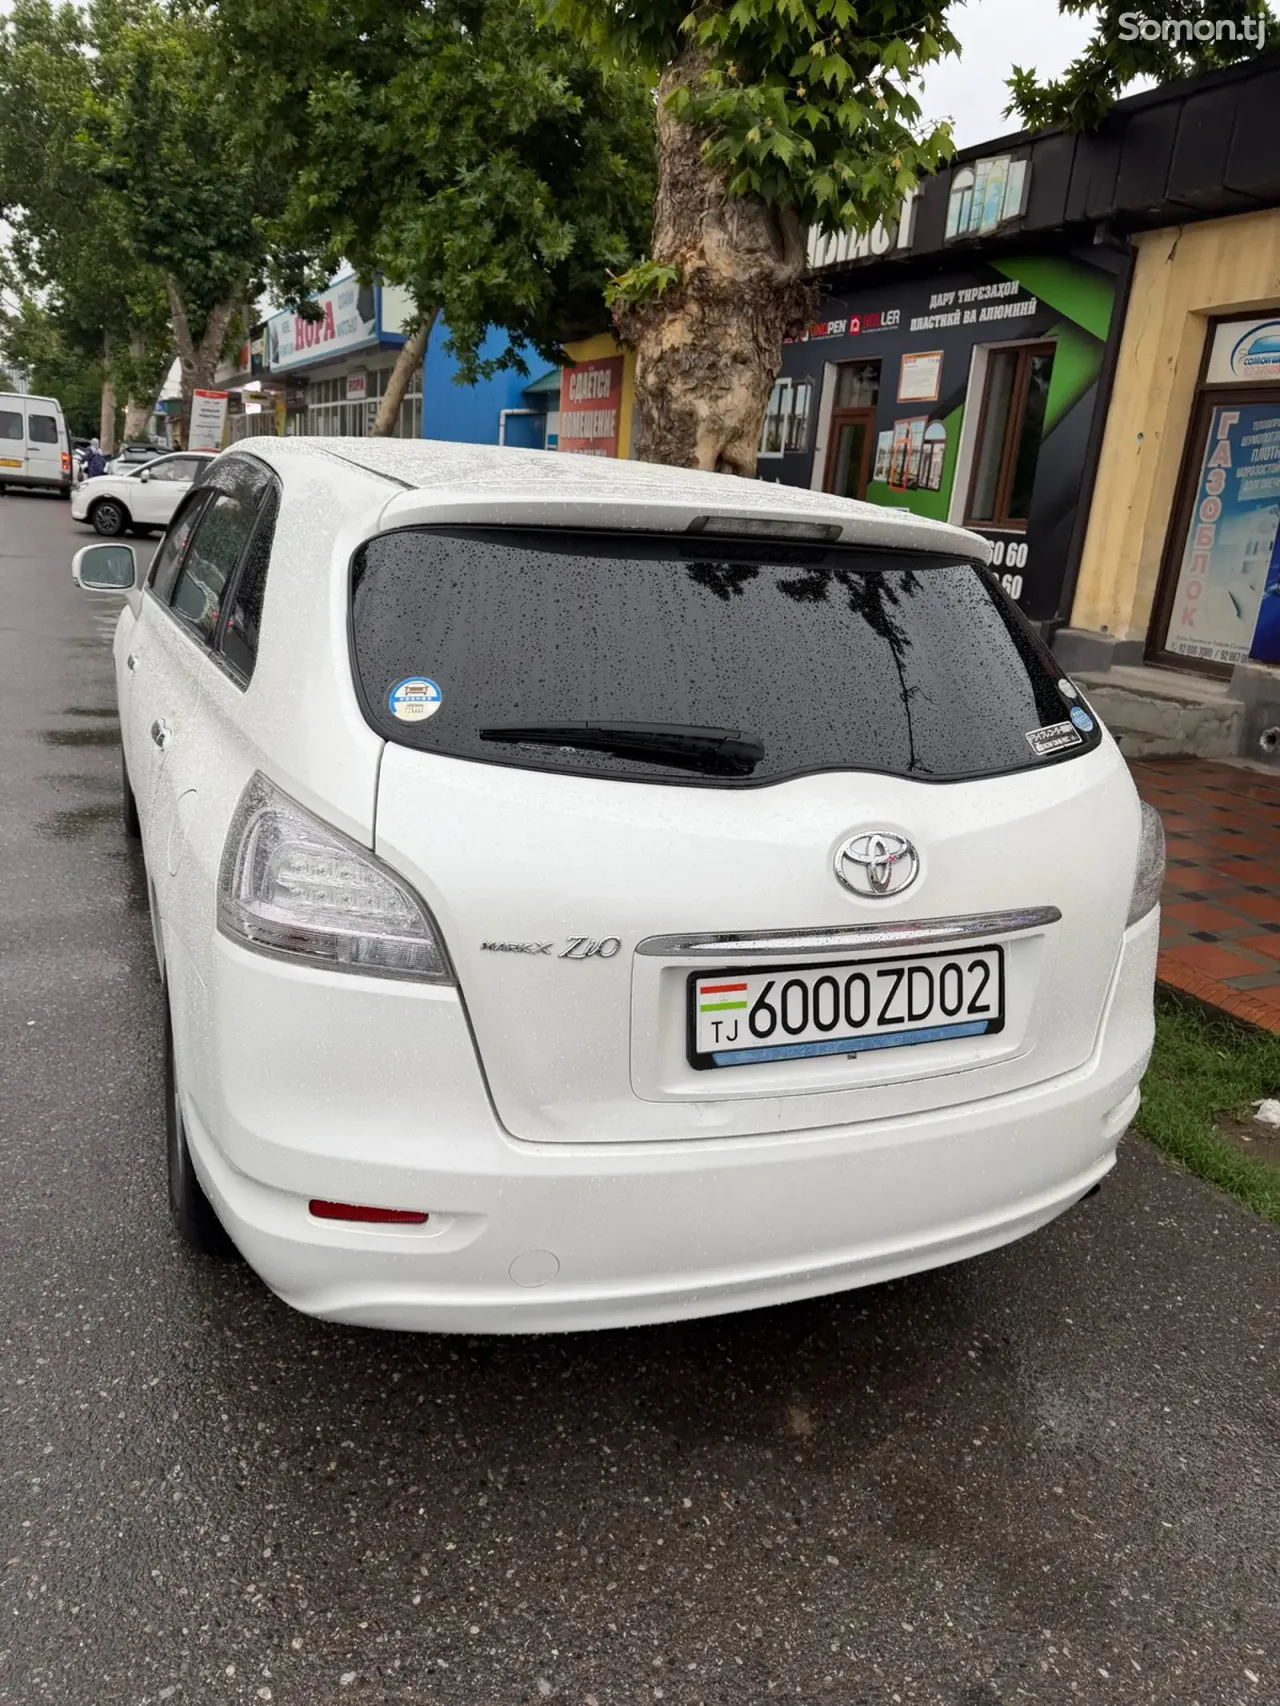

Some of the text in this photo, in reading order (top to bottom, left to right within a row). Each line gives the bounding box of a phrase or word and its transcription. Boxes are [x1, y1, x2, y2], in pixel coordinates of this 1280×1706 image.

[929, 291, 955, 309] ДАРУ
[1180, 411, 1240, 628] ГАЗОБЛОК
[1005, 542, 1029, 568] 60
[711, 959, 990, 1043] TJ 6000ZD02
